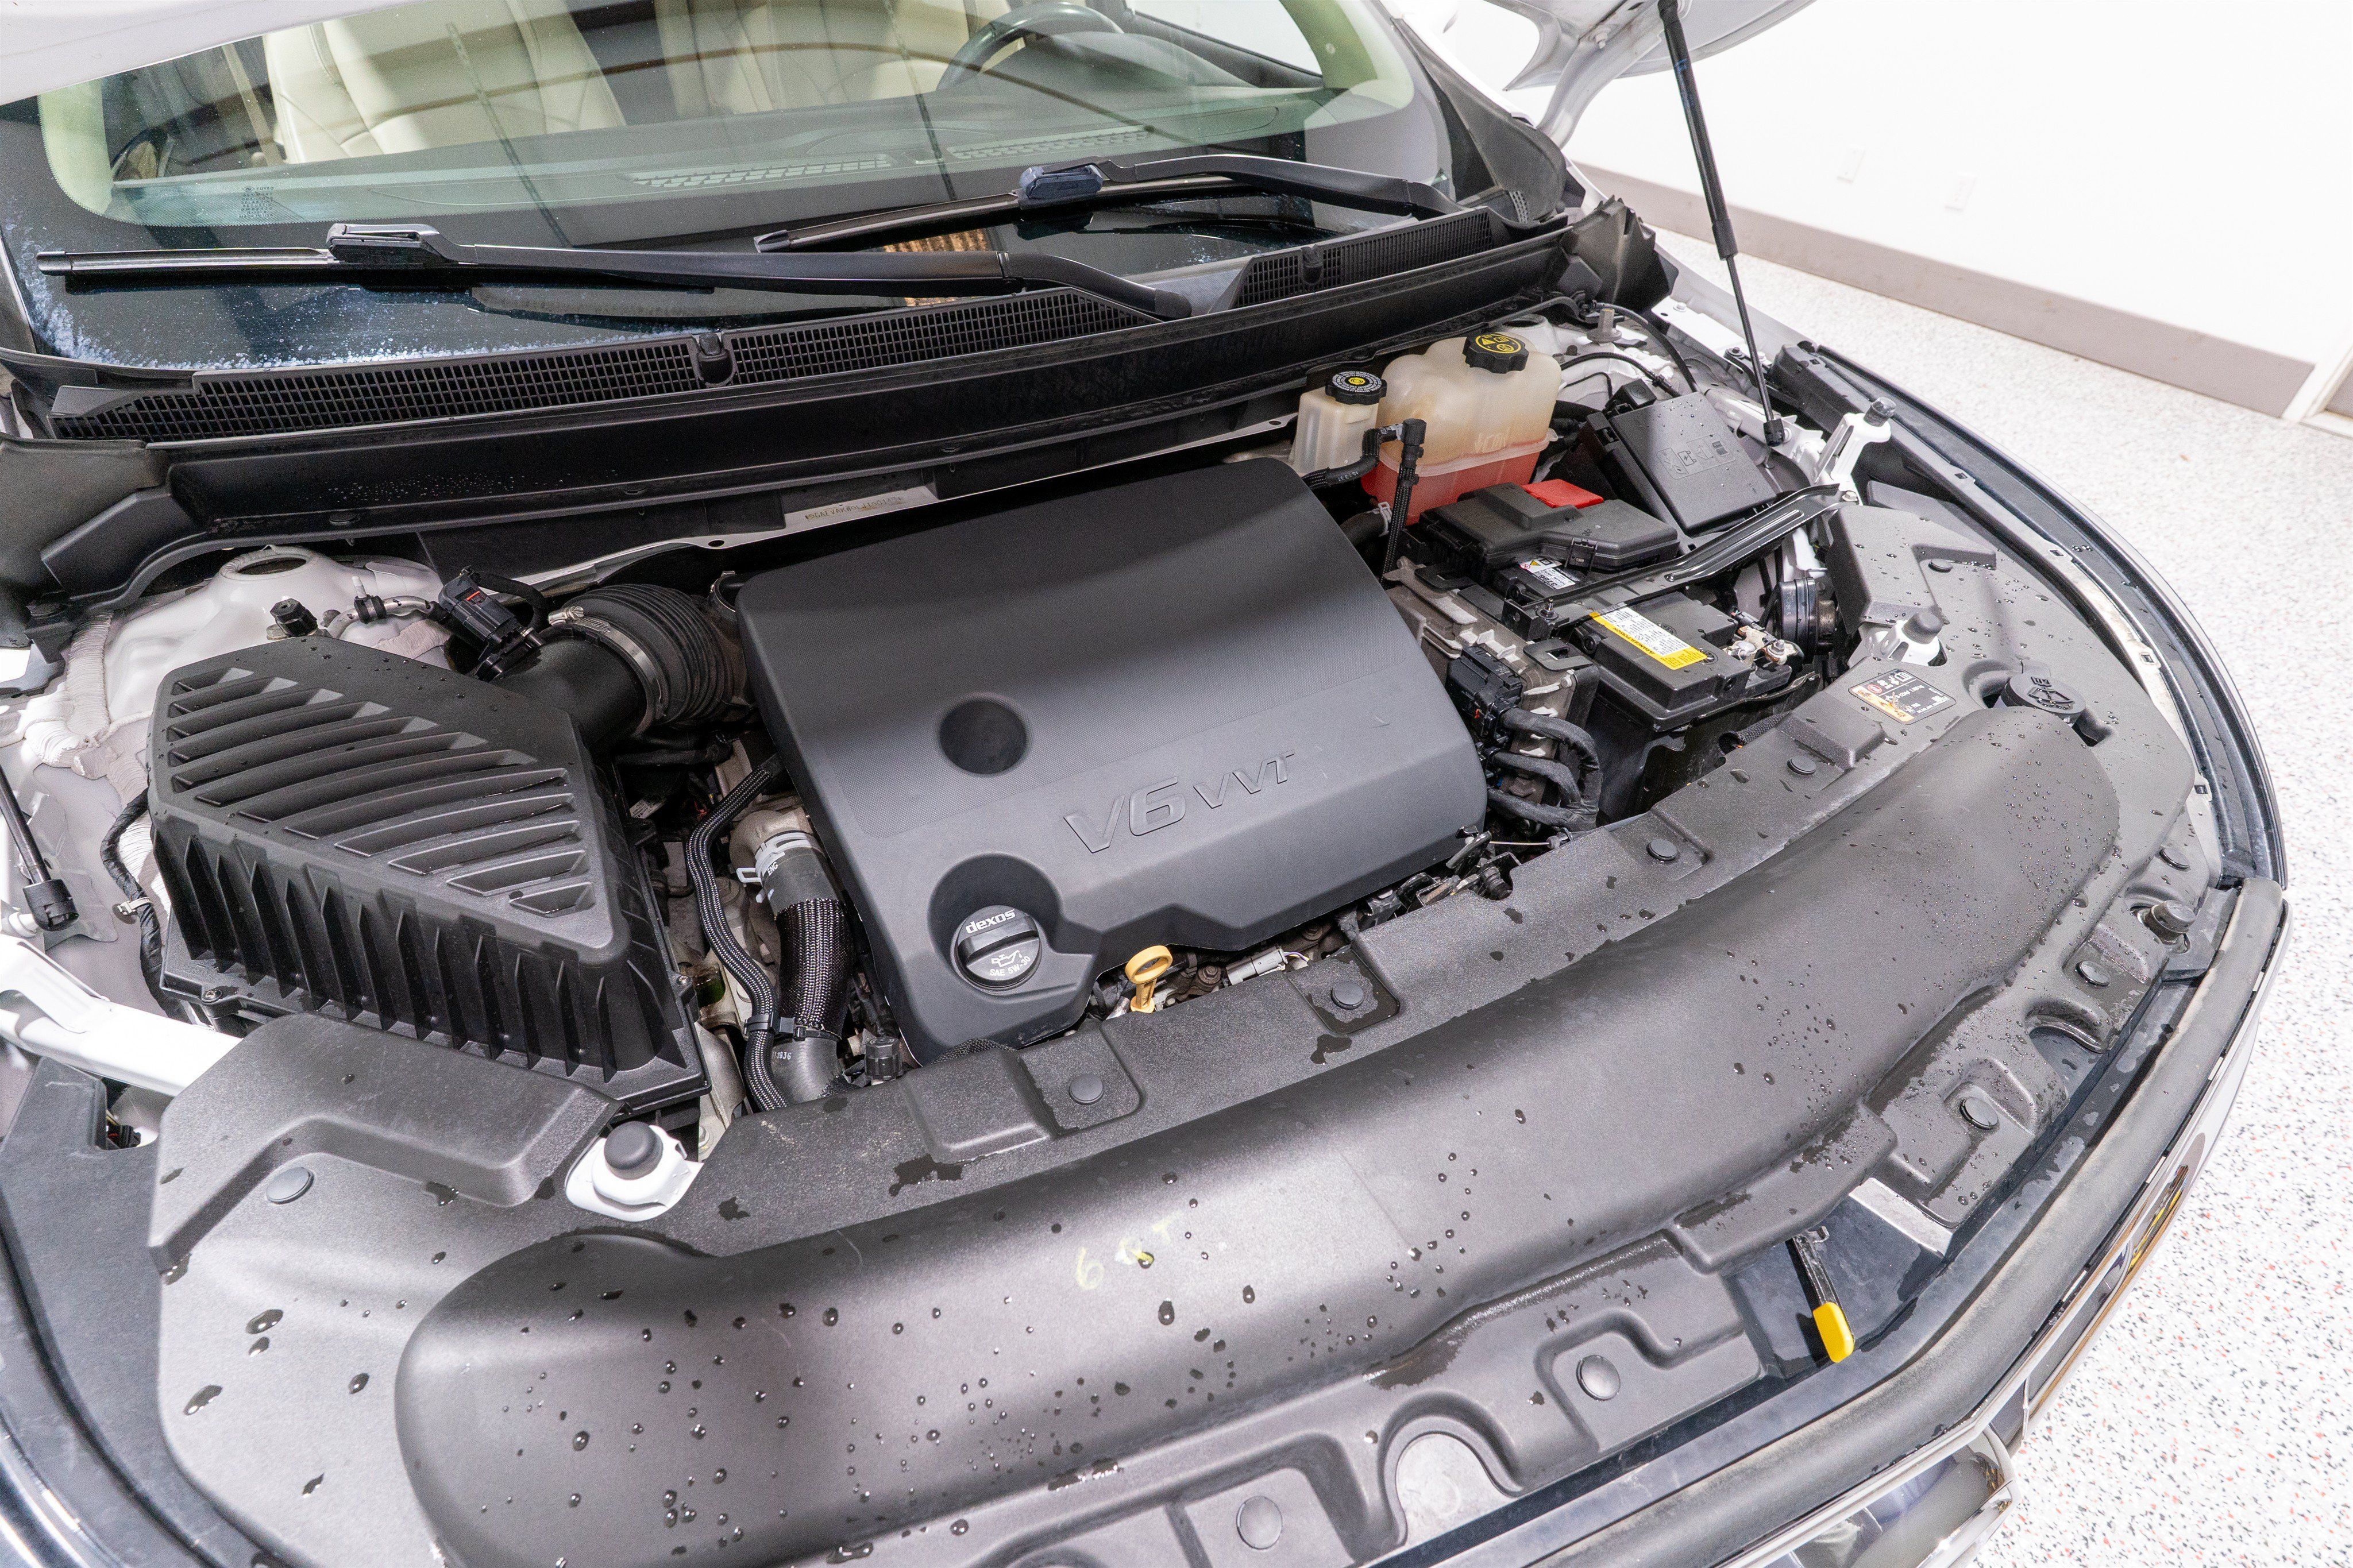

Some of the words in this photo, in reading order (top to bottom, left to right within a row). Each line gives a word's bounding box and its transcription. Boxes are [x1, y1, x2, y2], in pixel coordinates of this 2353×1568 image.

[1063, 776, 1186, 853] V6
[1193, 750, 1295, 809] VVT
[767, 862, 778, 876] ENG
[965, 909, 1016, 934] dexos
[989, 968, 1005, 976] SAE
[1008, 956, 1031, 975] 5W-30
